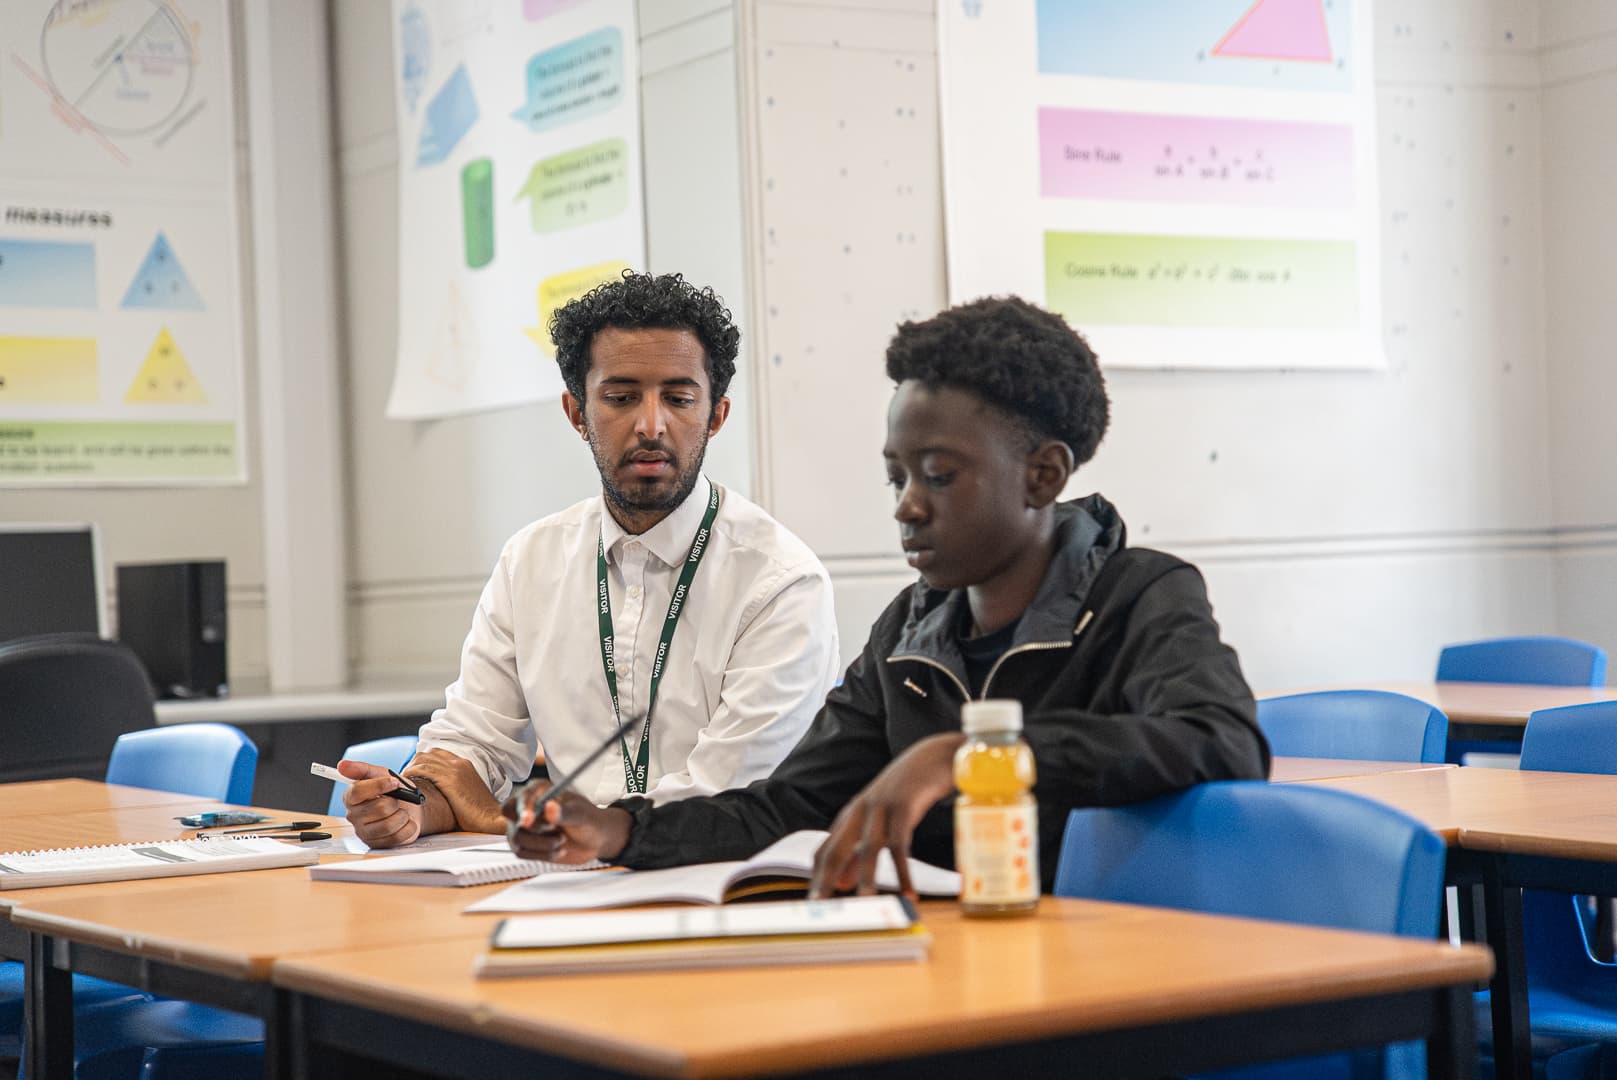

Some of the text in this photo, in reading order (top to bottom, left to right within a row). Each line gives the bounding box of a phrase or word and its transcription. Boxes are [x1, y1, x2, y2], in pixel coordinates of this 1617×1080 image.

[689, 528, 708, 562] VISITOR
[600, 578, 608, 614] VISITOR
[668, 584, 686, 619] VISITOR
[604, 636, 615, 672] VISITOR
[653, 641, 667, 678] VISITOR
[624, 756, 638, 793] VISITOR
